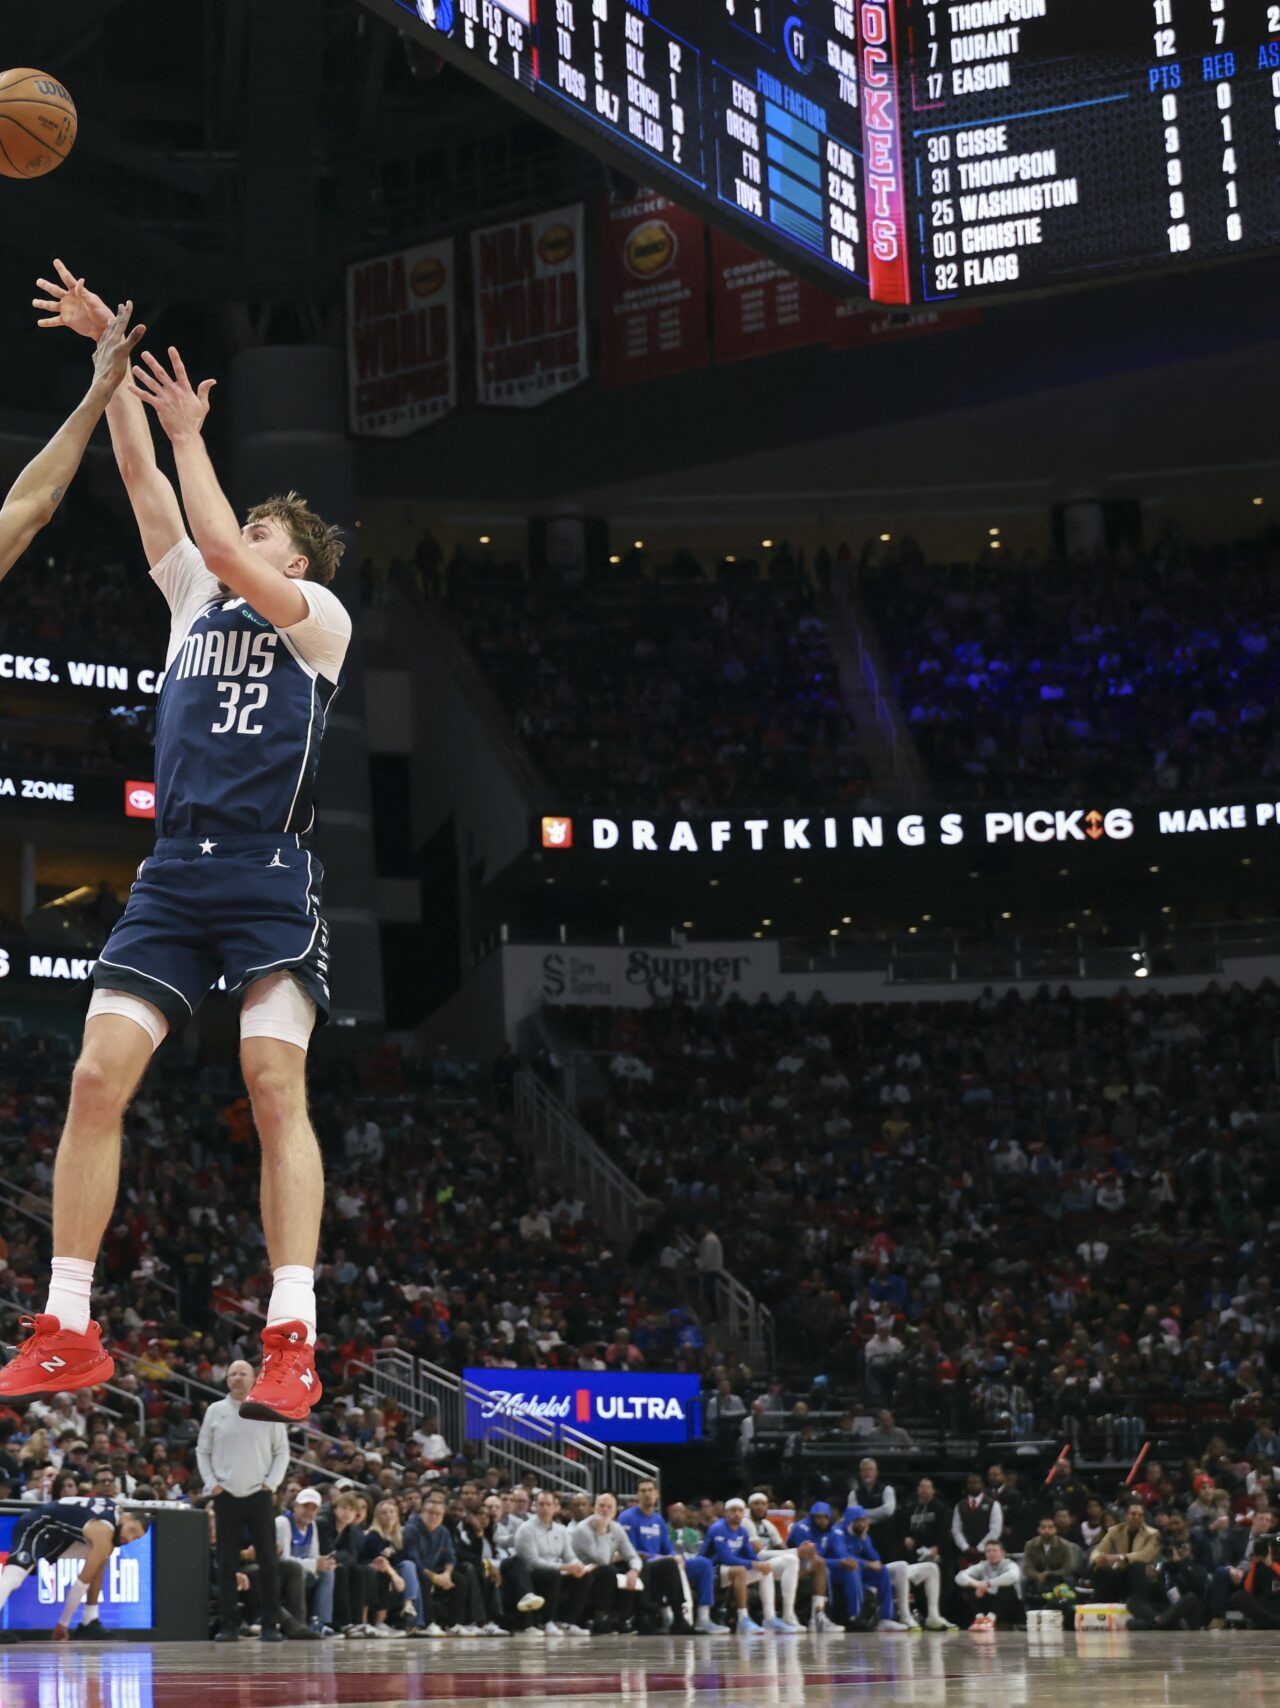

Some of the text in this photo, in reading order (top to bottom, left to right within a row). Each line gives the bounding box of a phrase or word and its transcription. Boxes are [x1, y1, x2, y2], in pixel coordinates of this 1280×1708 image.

[507, 16, 523, 52] CC
[556, 20, 600, 60] TO 1
[927, 0, 1172, 36] 1 THOMPSON 11
[928, 5, 1280, 67] 7 DURANT 12 7 2
[464, 19, 520, 80] 5 2 1
[625, 12, 681, 73] AST 12
[793, 30, 804, 60] FT
[558, 52, 604, 102] POSS 5
[626, 43, 677, 100] BLK 1
[927, 61, 1010, 99] 17 EASON
[1148, 42, 1280, 93] PTS REB AS
[627, 74, 660, 119] BENCH
[861, 3, 898, 261] OCKETS
[927, 82, 1231, 162] 30 CISSE 0 0
[673, 135, 681, 164] 2
[742, 150, 761, 184] FTR
[932, 114, 1232, 194] 31 THOMPSON 3 1
[931, 199, 954, 226] 25
[959, 178, 1078, 222] WASHINGTON
[1222, 147, 1237, 175] 4
[933, 231, 957, 258] 00
[961, 217, 1042, 254] CHRISTIE
[1226, 180, 1238, 208] 1
[935, 263, 958, 290] 32
[963, 254, 1019, 286] FLAGG
[67, 661, 129, 691] WIN
[176, 630, 278, 680] MAVS
[211, 681, 269, 735] 32
[21, 779, 74, 801] ZONE
[592, 813, 964, 852] DRAFTKINGS
[1158, 804, 1247, 834] MAKE
[626, 950, 749, 986] Supper
[481, 1389, 686, 1420] Michelob ULTRA
